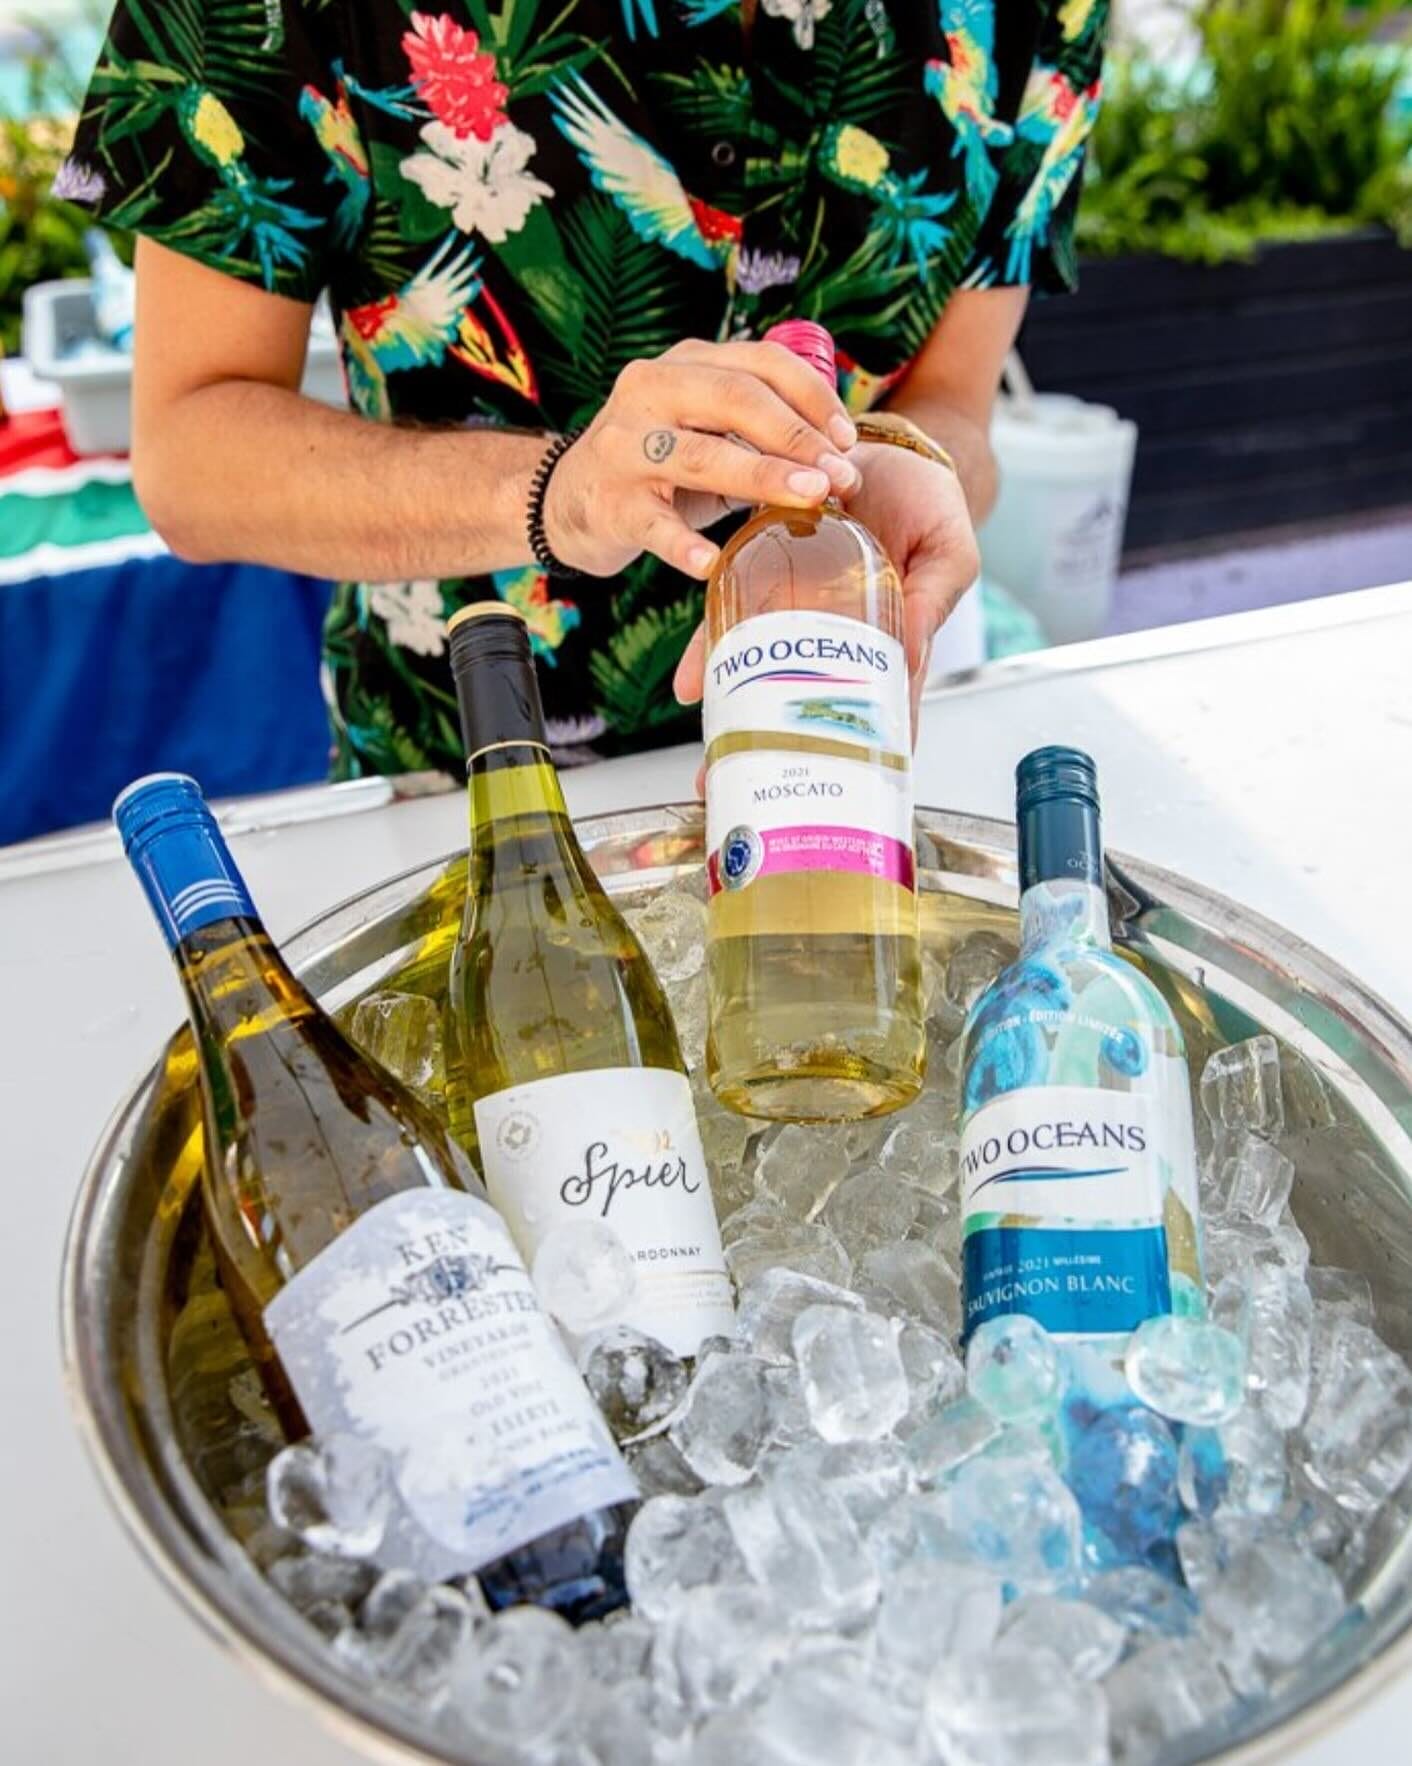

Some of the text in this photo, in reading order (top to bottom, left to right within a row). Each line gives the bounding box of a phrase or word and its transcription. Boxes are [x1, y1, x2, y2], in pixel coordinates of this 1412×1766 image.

[713, 638, 889, 685] TWO OCEANS
[782, 767, 811, 779] 2021
[752, 782, 844, 803] MOSCATO
[1007, 1122, 1147, 1157] OCEANS
[560, 1142, 701, 1217] Spier
[395, 1223, 470, 1267] KEN
[629, 1246, 702, 1262] RDONNAY
[1018, 1255, 1049, 1273] 2021
[1066, 1274, 1137, 1295] BLANC
